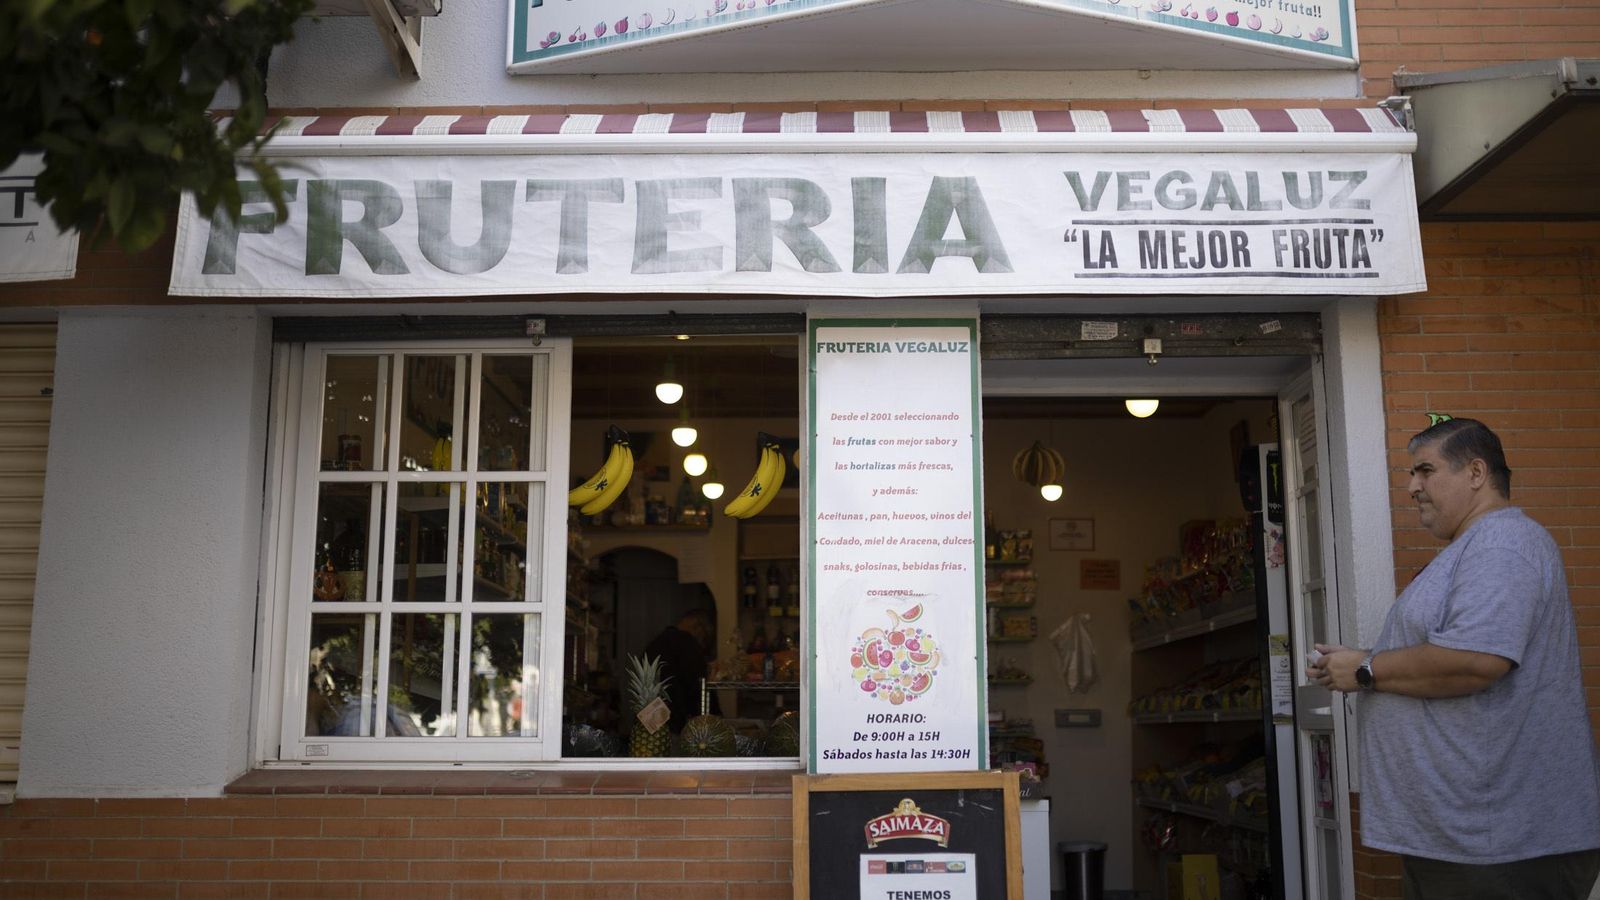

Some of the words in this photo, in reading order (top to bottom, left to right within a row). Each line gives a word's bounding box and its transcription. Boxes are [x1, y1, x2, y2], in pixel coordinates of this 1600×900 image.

[1063, 170, 1371, 212] VEGALUZ
[201, 174, 1014, 277] FRUTERIA
[1138, 229, 1251, 270] MEJOR
[817, 342, 892, 353] FRUTERIA
[895, 341, 969, 353] VEGALUZ
[831, 412, 858, 421] Desde
[860, 412, 869, 421] el
[871, 413, 892, 421] 2001
[894, 412, 960, 421] seleccionando
[832, 436, 846, 446] las
[847, 436, 876, 447] frutas
[896, 436, 923, 448] mejor
[925, 436, 950, 446] sabor
[951, 439, 958, 447] y
[835, 461, 848, 471] las
[850, 461, 896, 471] hortalizas
[898, 461, 917, 471] más
[918, 461, 954, 473] frescas,
[872, 488, 878, 496] y
[880, 485, 918, 496] además:
[818, 511, 863, 521] Aceitunas
[869, 513, 890, 522] pan,
[892, 511, 928, 521] huevos,
[930, 511, 955, 520] vinos
[957, 511, 972, 520] del
[864, 537, 885, 545] miel
[886, 537, 898, 545] de
[900, 537, 941, 546] Aracena,
[824, 562, 853, 572] snaks,
[854, 561, 901, 573] golosinas,
[902, 561, 939, 571] bebidas
[940, 562, 962, 573] frias
[866, 713, 927, 724] HORARIO:
[853, 731, 869, 742] De
[871, 731, 905, 742] 9:00H
[908, 734, 915, 742] a
[918, 731, 941, 741] 15H
[823, 748, 873, 760] Sábados
[875, 749, 906, 760] hasta
[910, 748, 928, 759] las
[931, 749, 971, 759] 14:30H
[869, 815, 945, 837] SAIMAZA
[887, 890, 952, 900] TENEMOS
